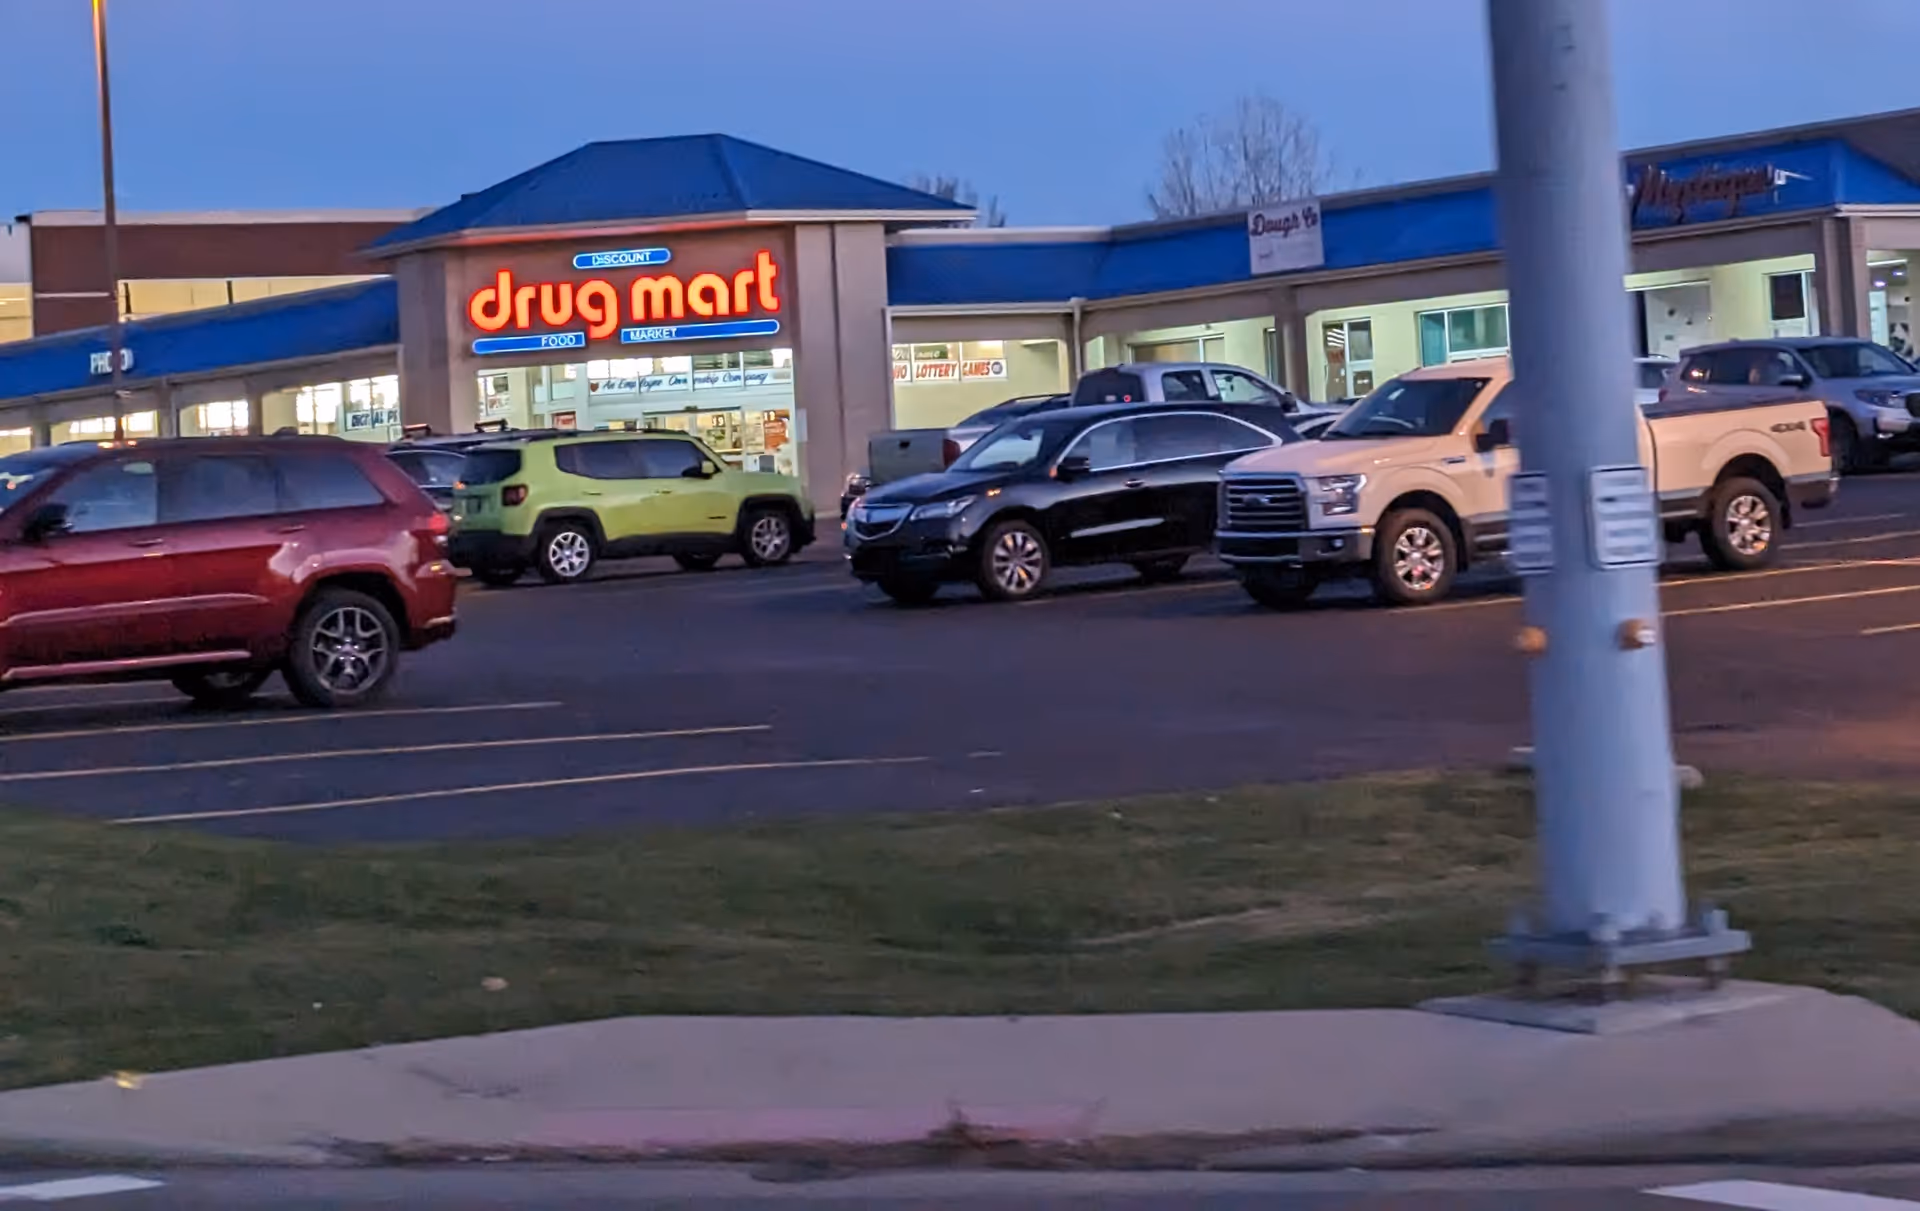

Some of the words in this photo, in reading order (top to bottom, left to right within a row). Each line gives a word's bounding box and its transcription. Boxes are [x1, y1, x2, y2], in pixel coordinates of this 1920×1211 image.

[1250, 212, 1299, 238] Dough
[592, 251, 652, 266] DISCOUNT
[469, 268, 620, 340] drug
[629, 249, 780, 322] mart
[541, 335, 577, 347] FOOD
[630, 327, 678, 341] MARKET
[89, 348, 134, 374] PHOO
[916, 361, 959, 378] LOTTERY
[962, 360, 990, 376] GAMES
